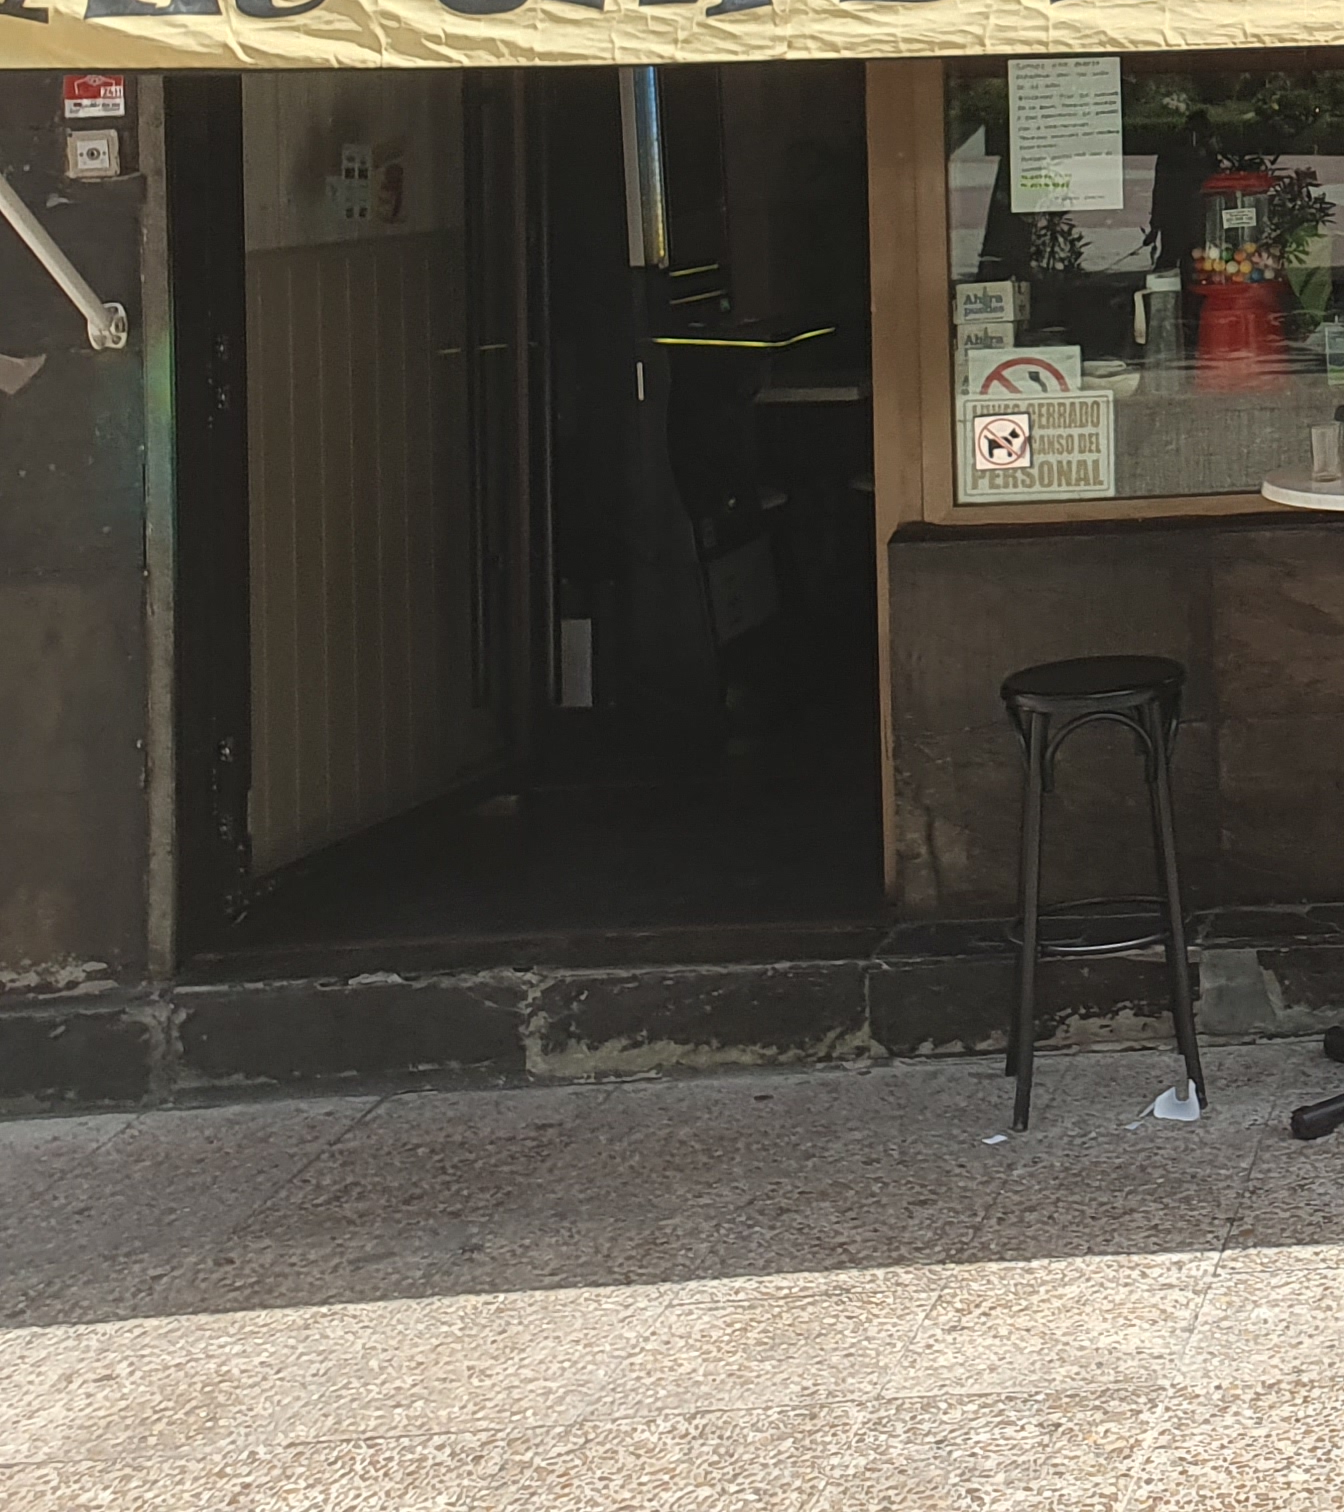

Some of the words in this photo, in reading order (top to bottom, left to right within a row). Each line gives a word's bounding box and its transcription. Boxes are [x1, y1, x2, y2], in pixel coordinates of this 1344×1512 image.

[963, 293, 1003, 306] Ahra
[964, 334, 1004, 346] Ahra
[1026, 400, 1101, 430] CERRADO
[1031, 433, 1075, 456] CANSO
[1078, 432, 1102, 454] DEL
[972, 458, 1104, 490] PERSONAL
